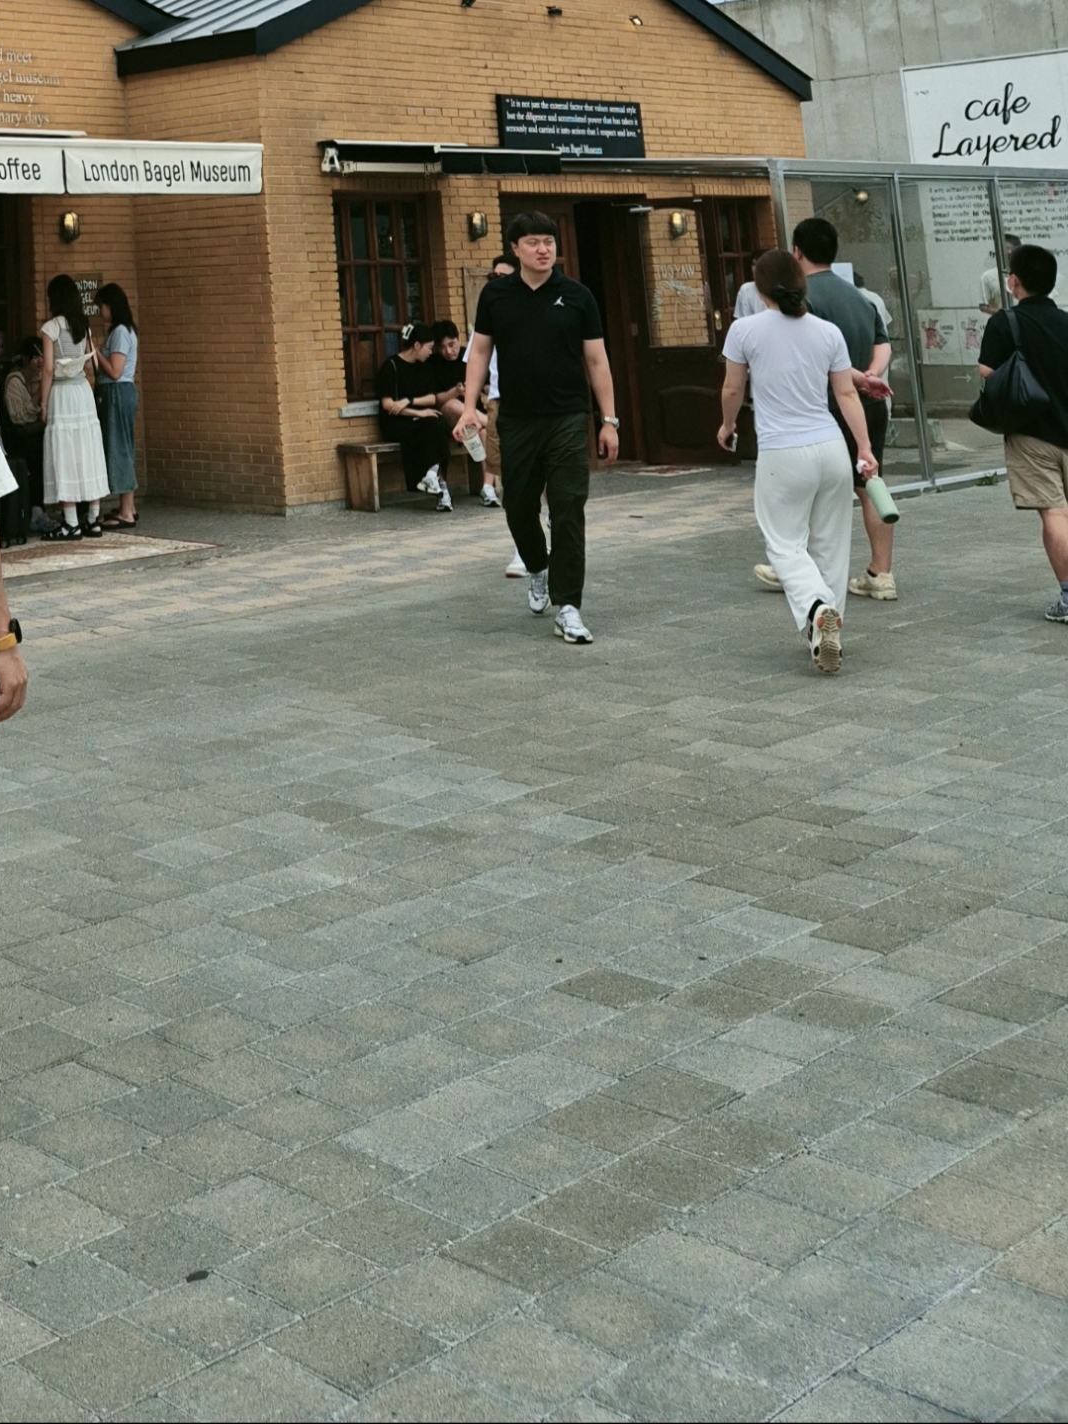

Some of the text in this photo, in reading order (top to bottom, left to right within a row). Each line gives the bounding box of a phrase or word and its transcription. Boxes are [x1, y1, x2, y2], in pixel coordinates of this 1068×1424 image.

[6, 51, 32, 63] meet
[15, 73, 60, 85] museum
[3, 89, 35, 107] heavy
[25, 110, 50, 127] days
[932, 115, 1062, 166] Layered
[81, 159, 251, 187] London Bagel Museum
